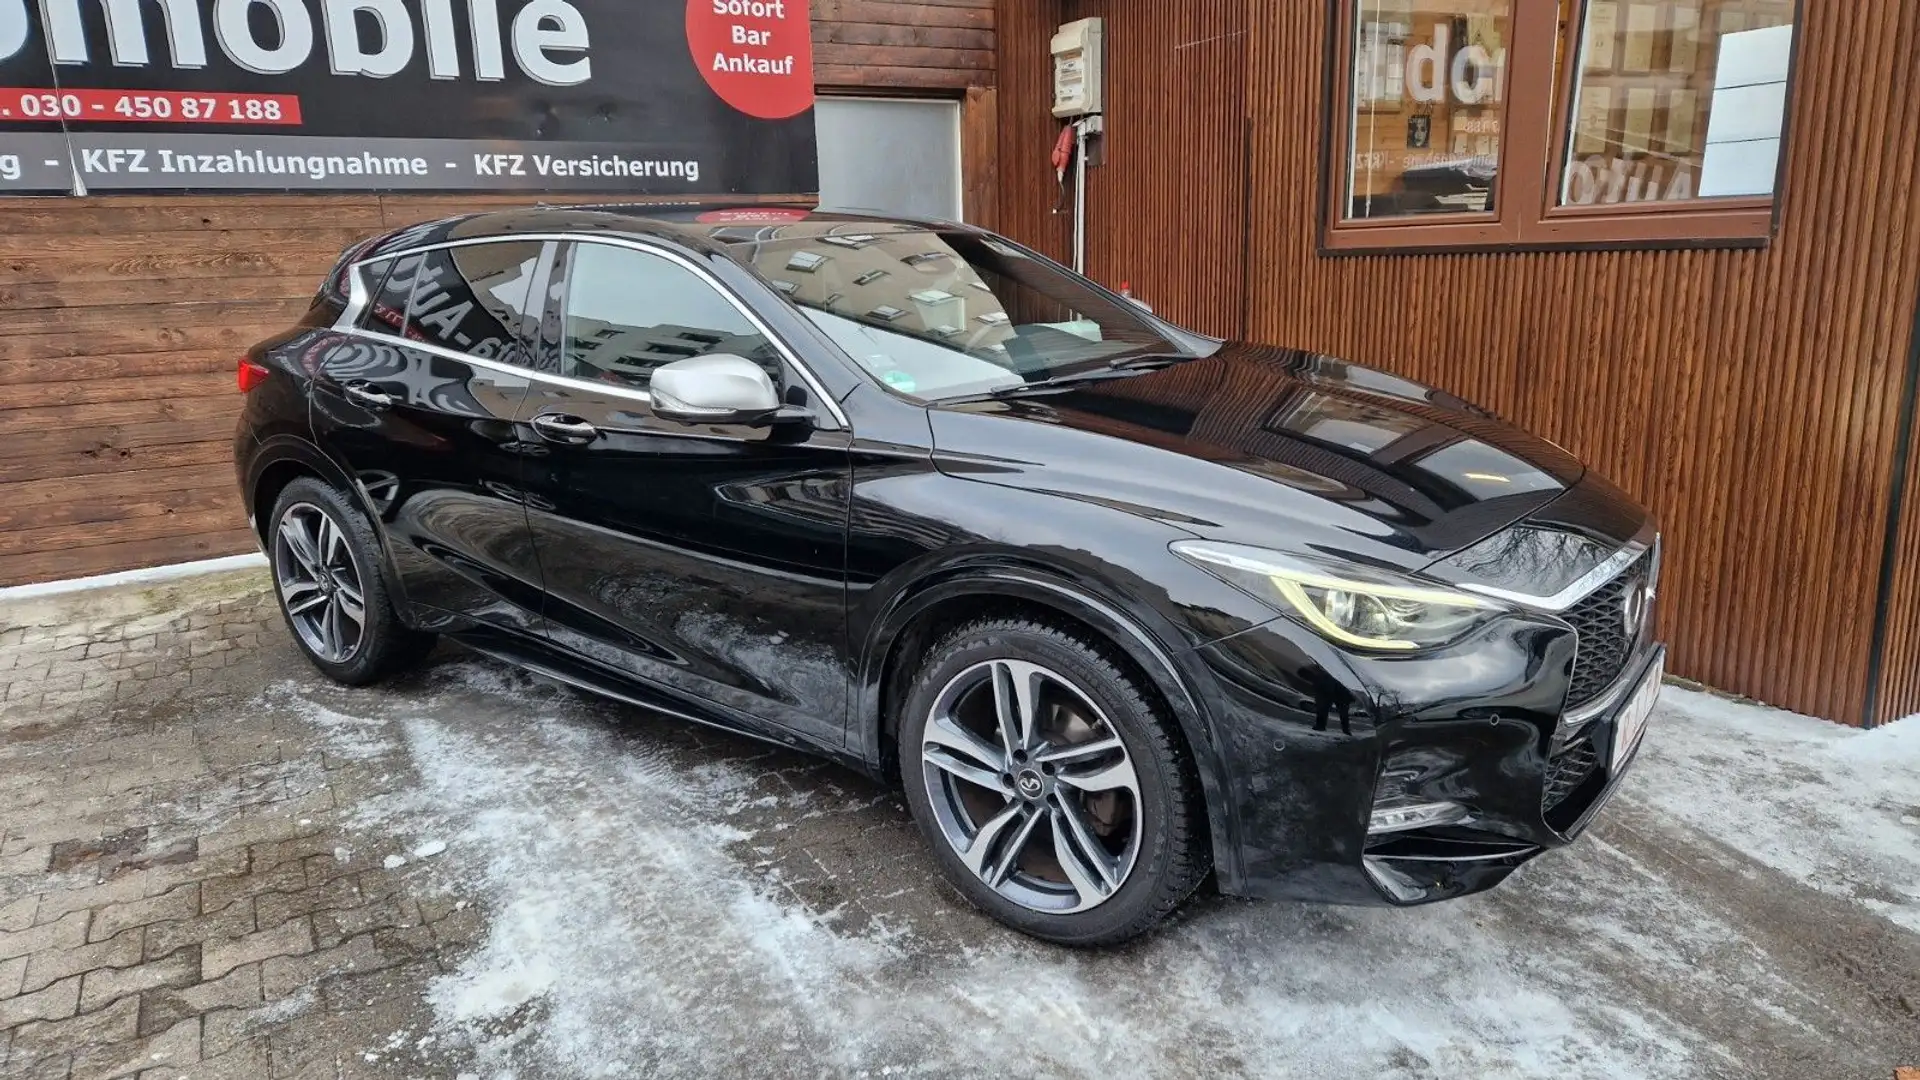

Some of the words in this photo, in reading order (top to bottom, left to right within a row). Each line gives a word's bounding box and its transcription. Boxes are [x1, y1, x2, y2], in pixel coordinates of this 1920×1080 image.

[713, 0, 785, 18] Sofort
[732, 25, 771, 46] Bar
[713, 52, 794, 75] Ankauf
[20, 94, 81, 118] 030
[114, 96, 172, 119] 450
[181, 97, 217, 119] 87
[228, 99, 282, 120] 188
[81, 149, 149, 173] KFZ
[158, 149, 428, 180] Inzahlungnahme
[474, 153, 526, 176] KFZ
[533, 154, 700, 182] Versicherung
